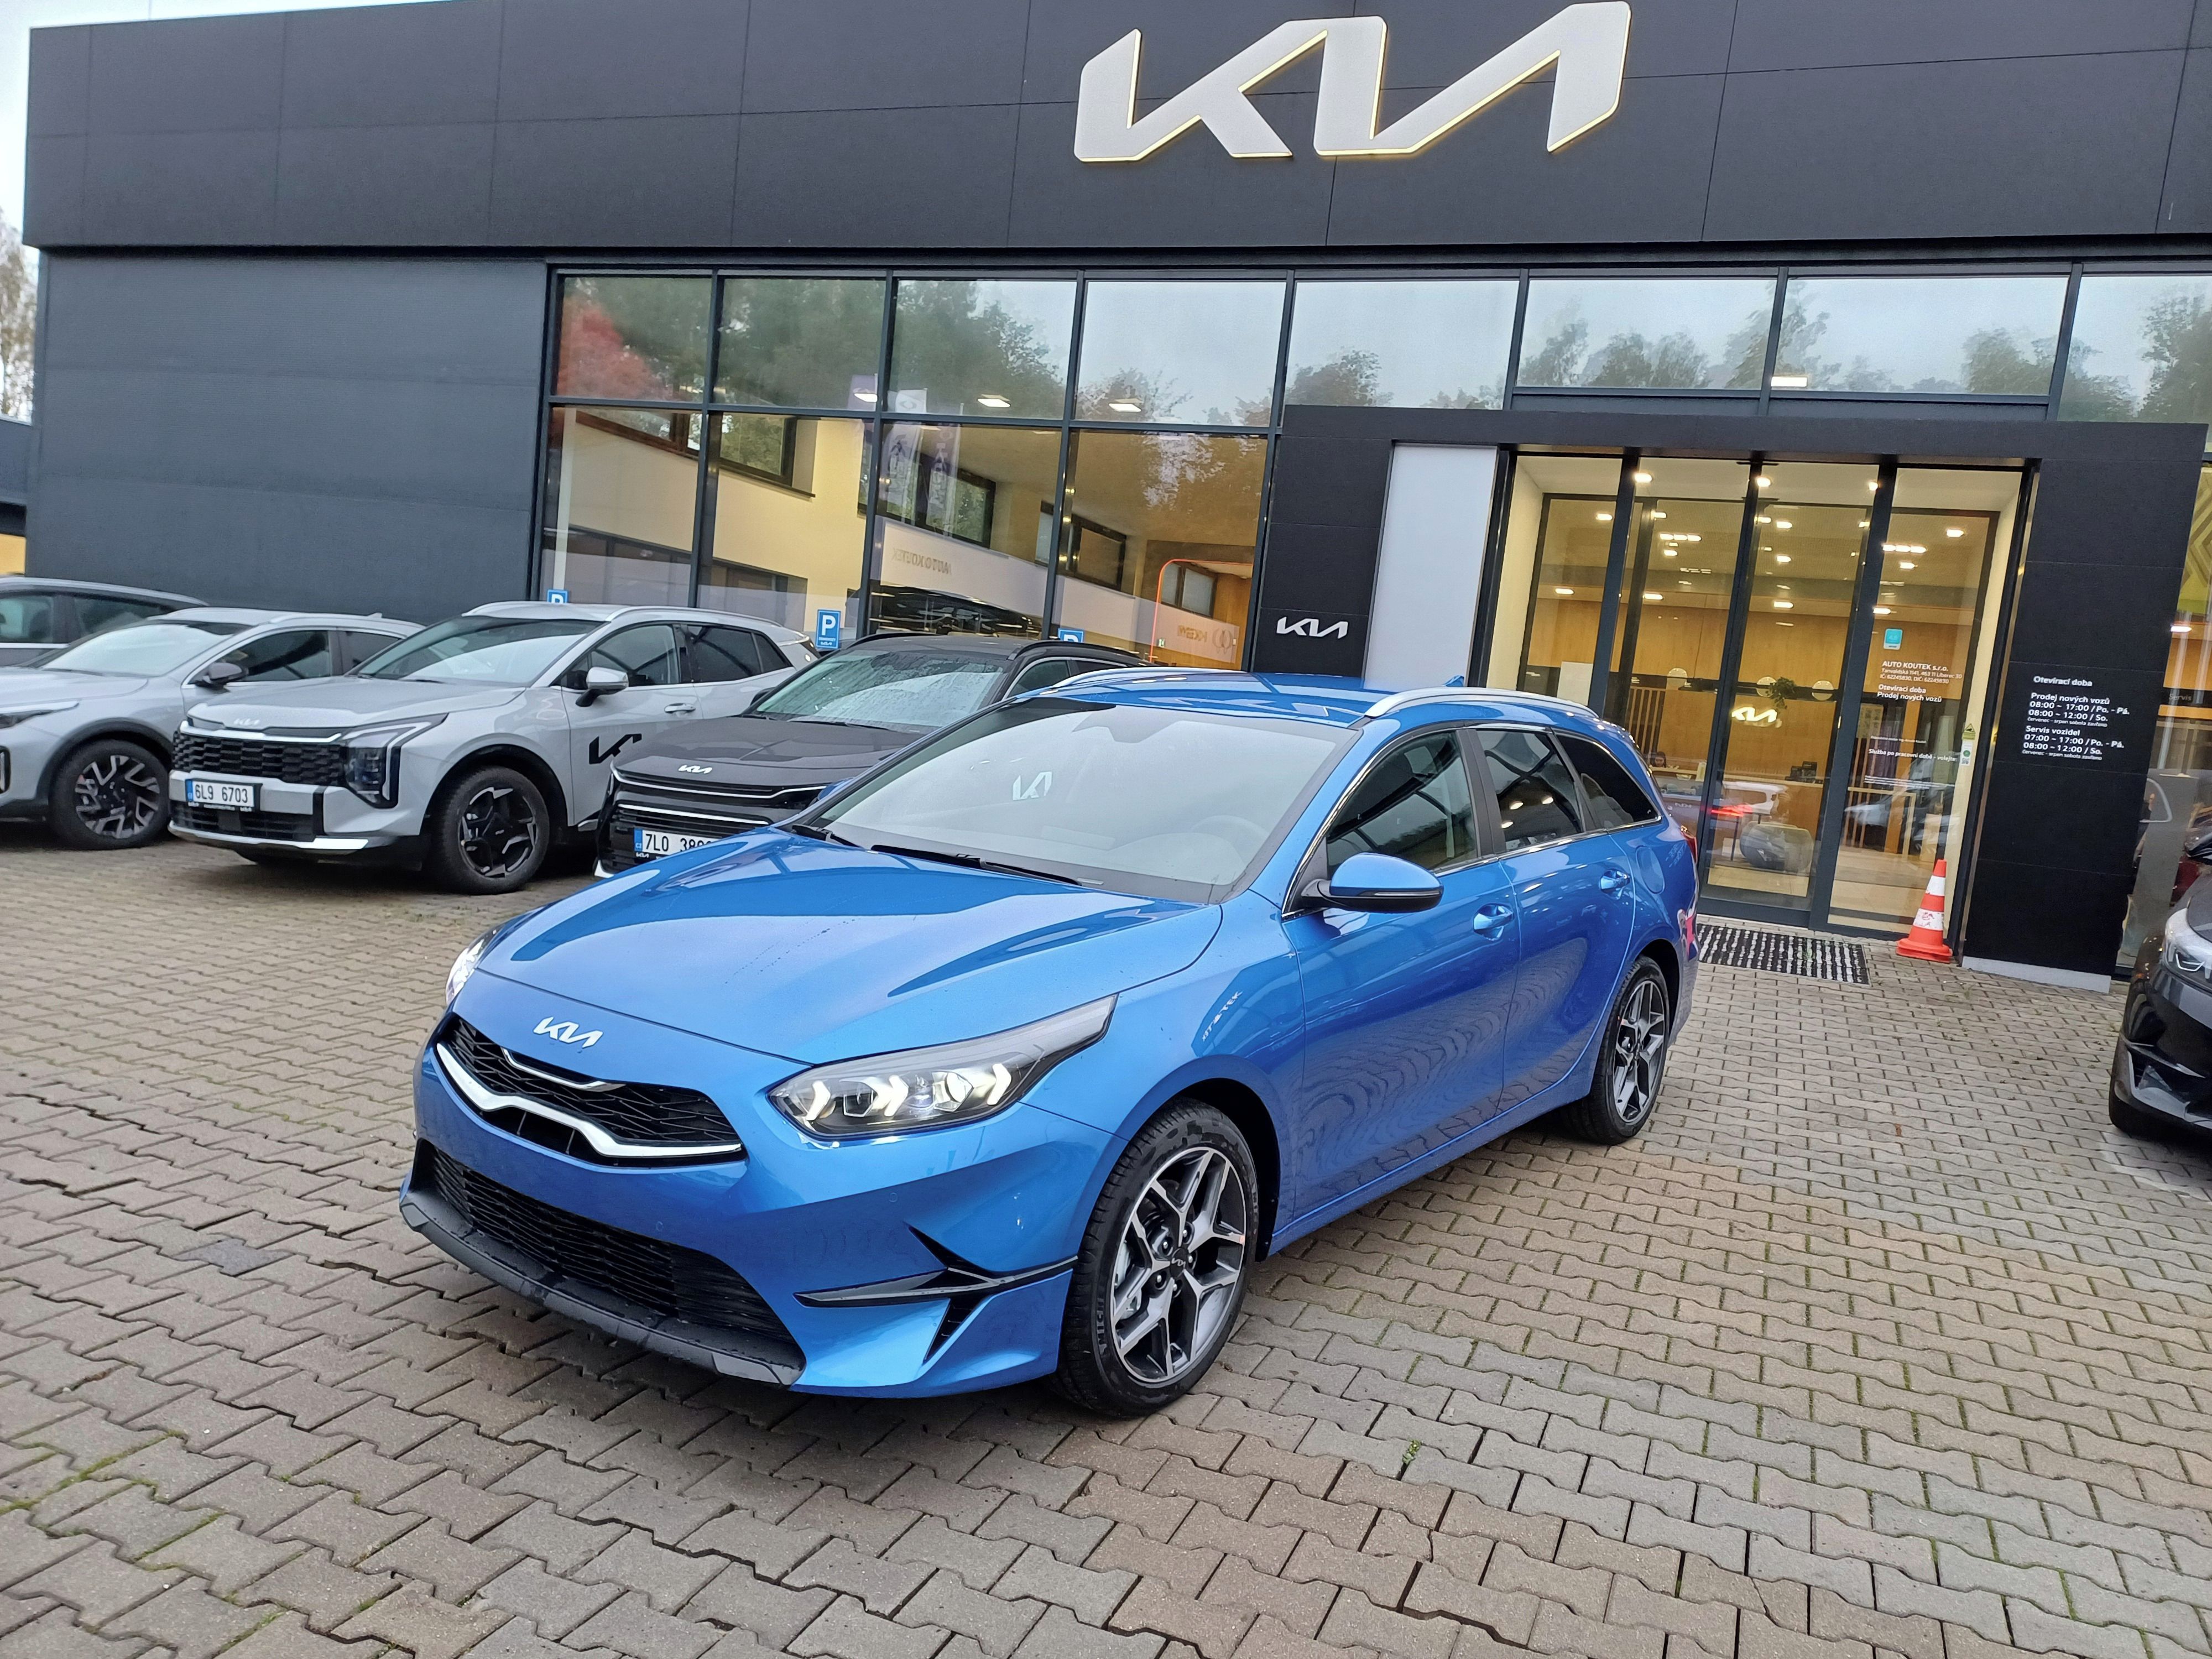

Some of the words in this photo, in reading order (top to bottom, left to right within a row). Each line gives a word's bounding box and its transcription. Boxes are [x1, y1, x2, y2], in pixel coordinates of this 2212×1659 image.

[1074, 1, 1631, 163] KIA
[821, 614, 836, 636] P
[1276, 617, 1348, 639] KIA
[2033, 675, 2070, 685] Otevírací
[2072, 678, 2093, 687] doba
[1877, 691, 1899, 700] Prodej
[1900, 694, 1924, 702] nových
[2031, 692, 2058, 702] Prodej
[2059, 695, 2089, 704] nových
[2029, 701, 2055, 709] 08:00
[2065, 703, 2089, 712] 17:00
[2028, 709, 2054, 717] 08:00
[2064, 712, 2088, 720] 12:00
[2026, 725, 2050, 734] Servis
[2052, 728, 2080, 736] vozidel
[2024, 733, 2049, 742] 07:00
[2059, 737, 2084, 745] 17:00
[2023, 742, 2048, 750] 08:00
[2057, 745, 2083, 753] 12:00
[678, 765, 712, 774] KIA
[195, 784, 213, 800] 6L9
[222, 787, 248, 803] 6703
[680, 838, 712, 852] 38
[533, 1016, 603, 1049] KIA
